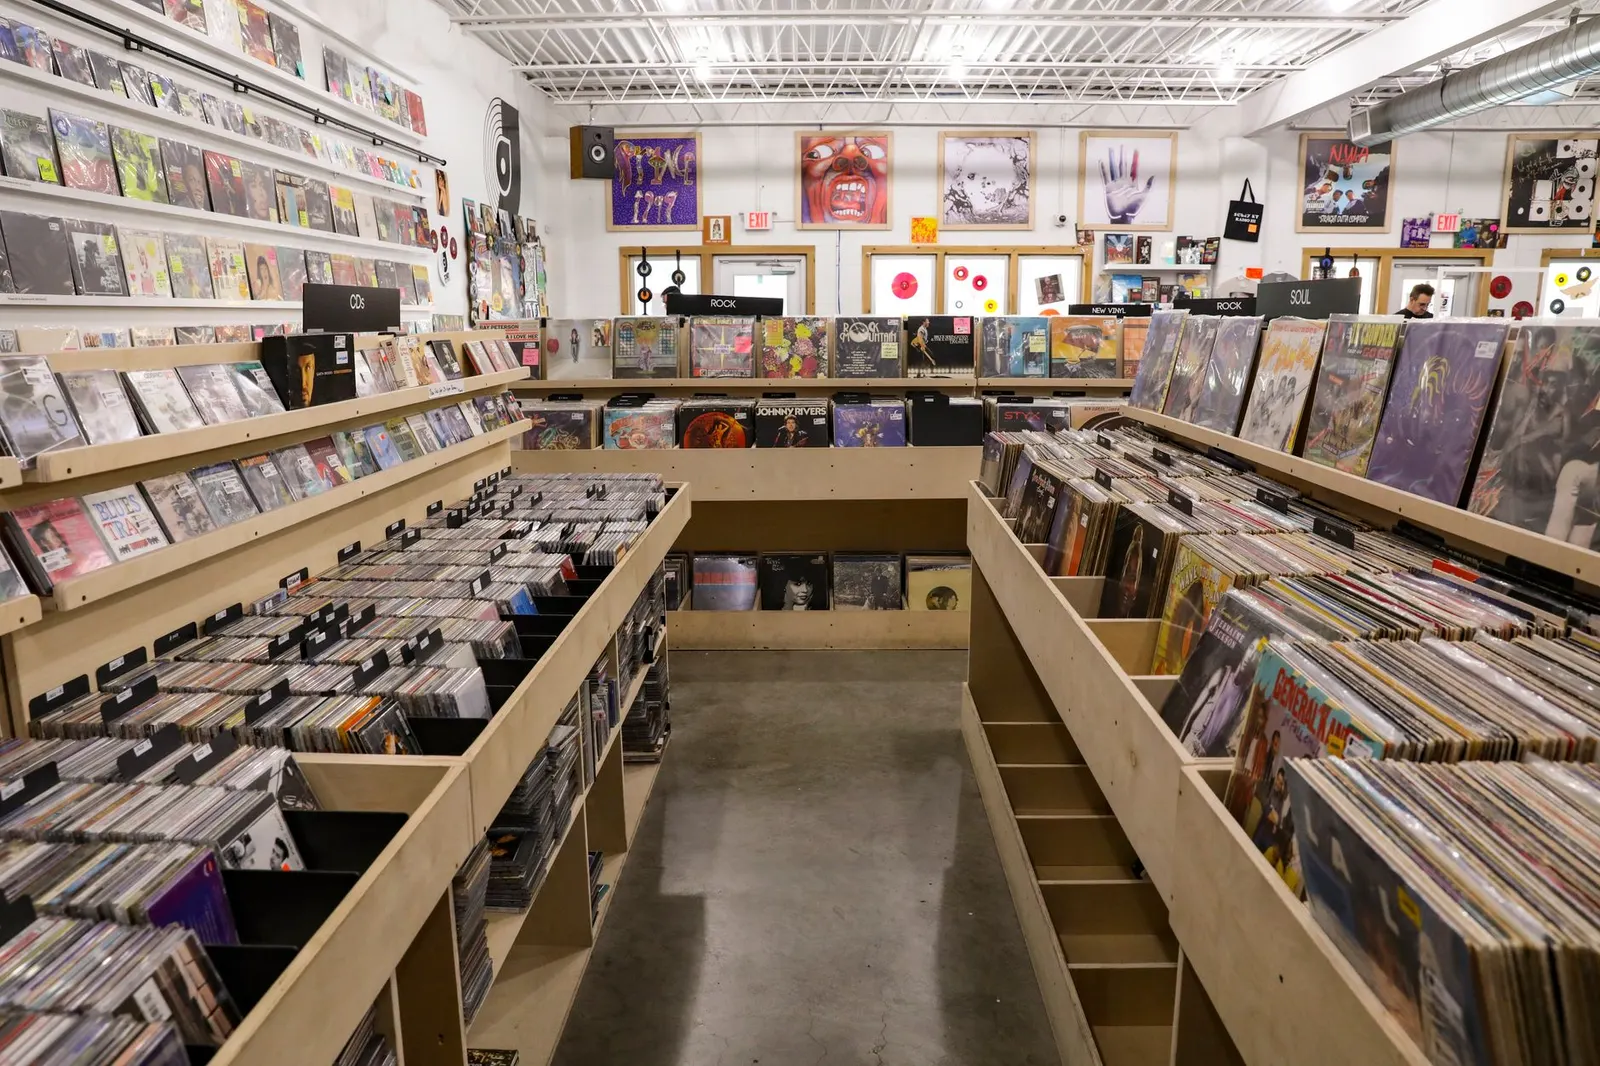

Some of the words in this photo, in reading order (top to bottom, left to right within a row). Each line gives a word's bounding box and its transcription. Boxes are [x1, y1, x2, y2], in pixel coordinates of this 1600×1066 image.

[749, 212, 769, 228] EXIT
[1437, 215, 1458, 231] EXIT
[350, 294, 365, 309] CDs
[710, 299, 736, 309] ROCK
[1290, 289, 1311, 305] SOUL
[1216, 301, 1242, 311] ROCK
[756, 408, 794, 416] JOHNNY
[795, 407, 827, 416] RIVERS
[1003, 411, 1041, 420] STYX
[92, 494, 141, 521] BLUES
[1208, 617, 1245, 644] JERMAINE
[1272, 667, 1320, 738] GENERAL
